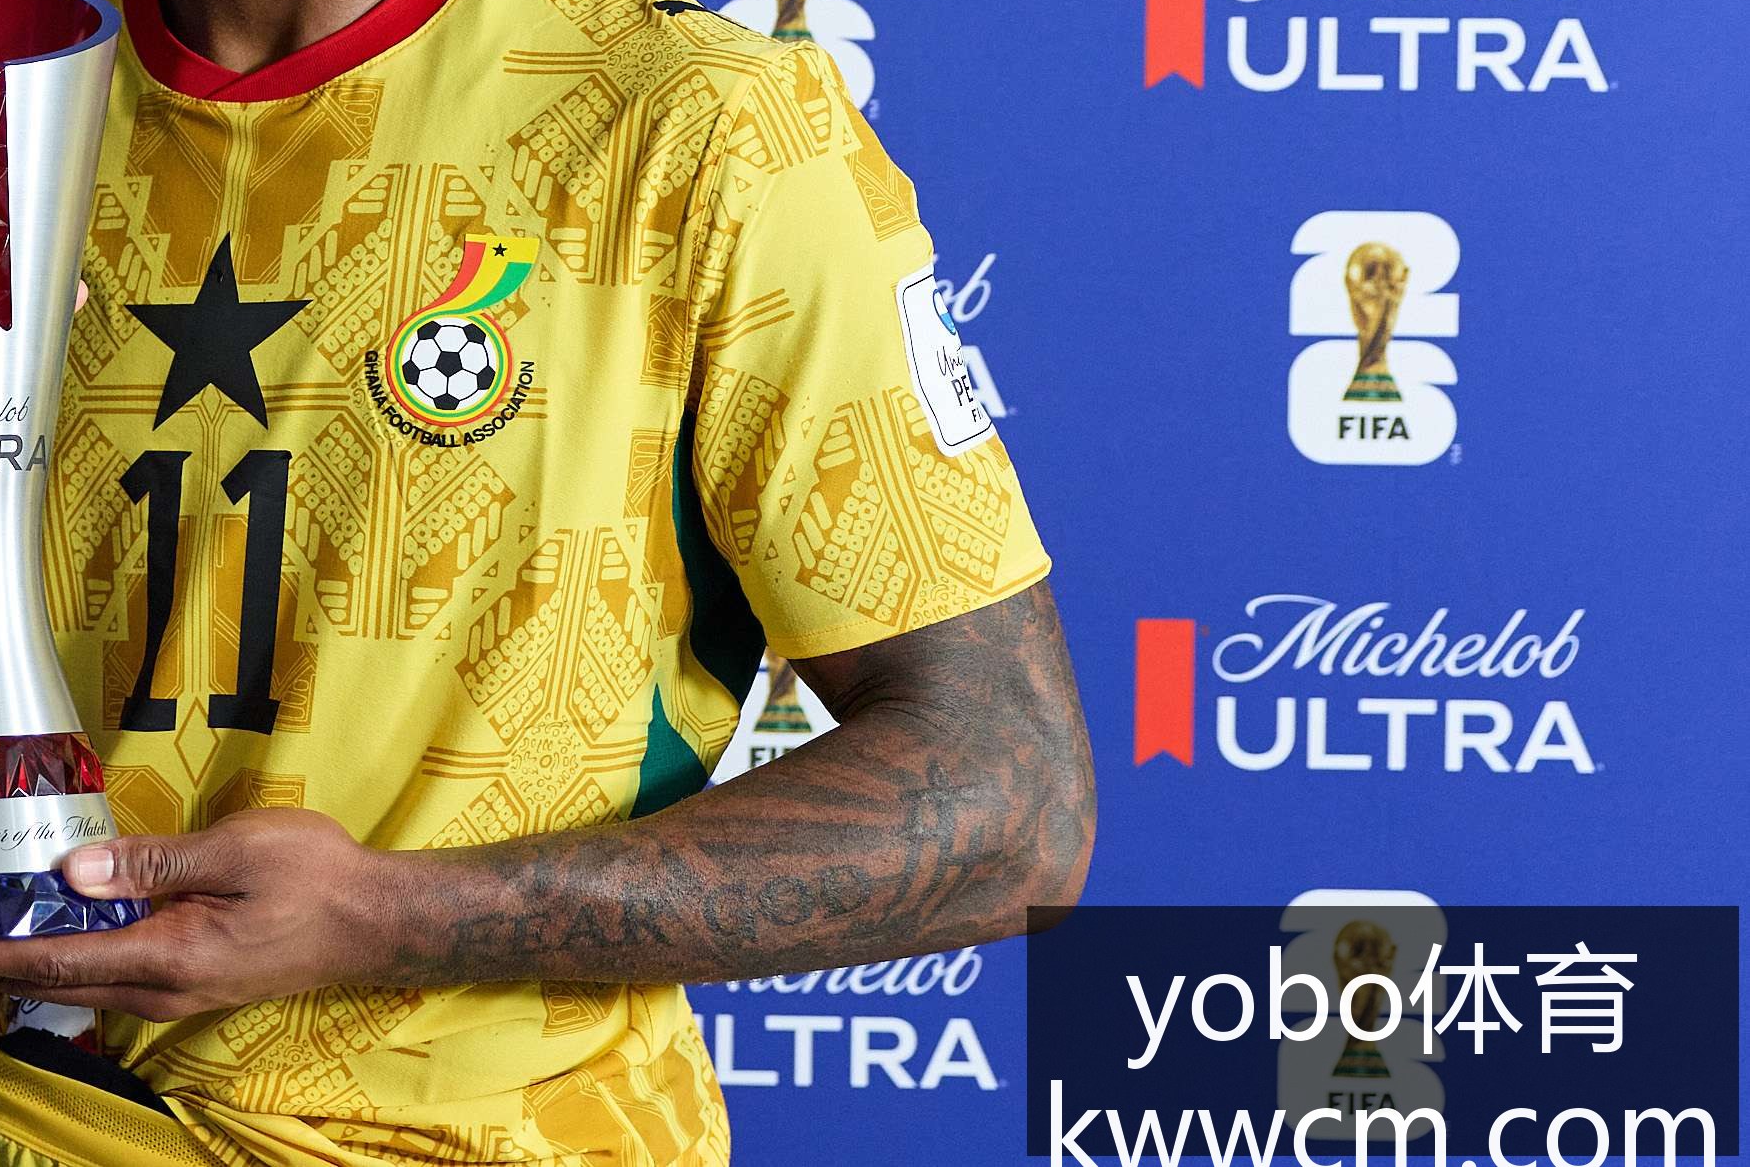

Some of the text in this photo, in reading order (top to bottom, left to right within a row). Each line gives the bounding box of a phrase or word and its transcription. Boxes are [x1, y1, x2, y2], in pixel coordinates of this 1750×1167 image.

[1228, 17, 1609, 92] ULTRA
[364, 350, 536, 448] GHANA FOOTBALL ASSOCIATION
[1339, 417, 1409, 439] FIFA
[118, 449, 293, 736] 11
[1213, 595, 1585, 682] Michelob
[1217, 696, 1595, 774] ULTRA
[63, 815, 107, 841] Match
[703, 864, 872, 942] GOD
[693, 1014, 999, 1091] LTRA
